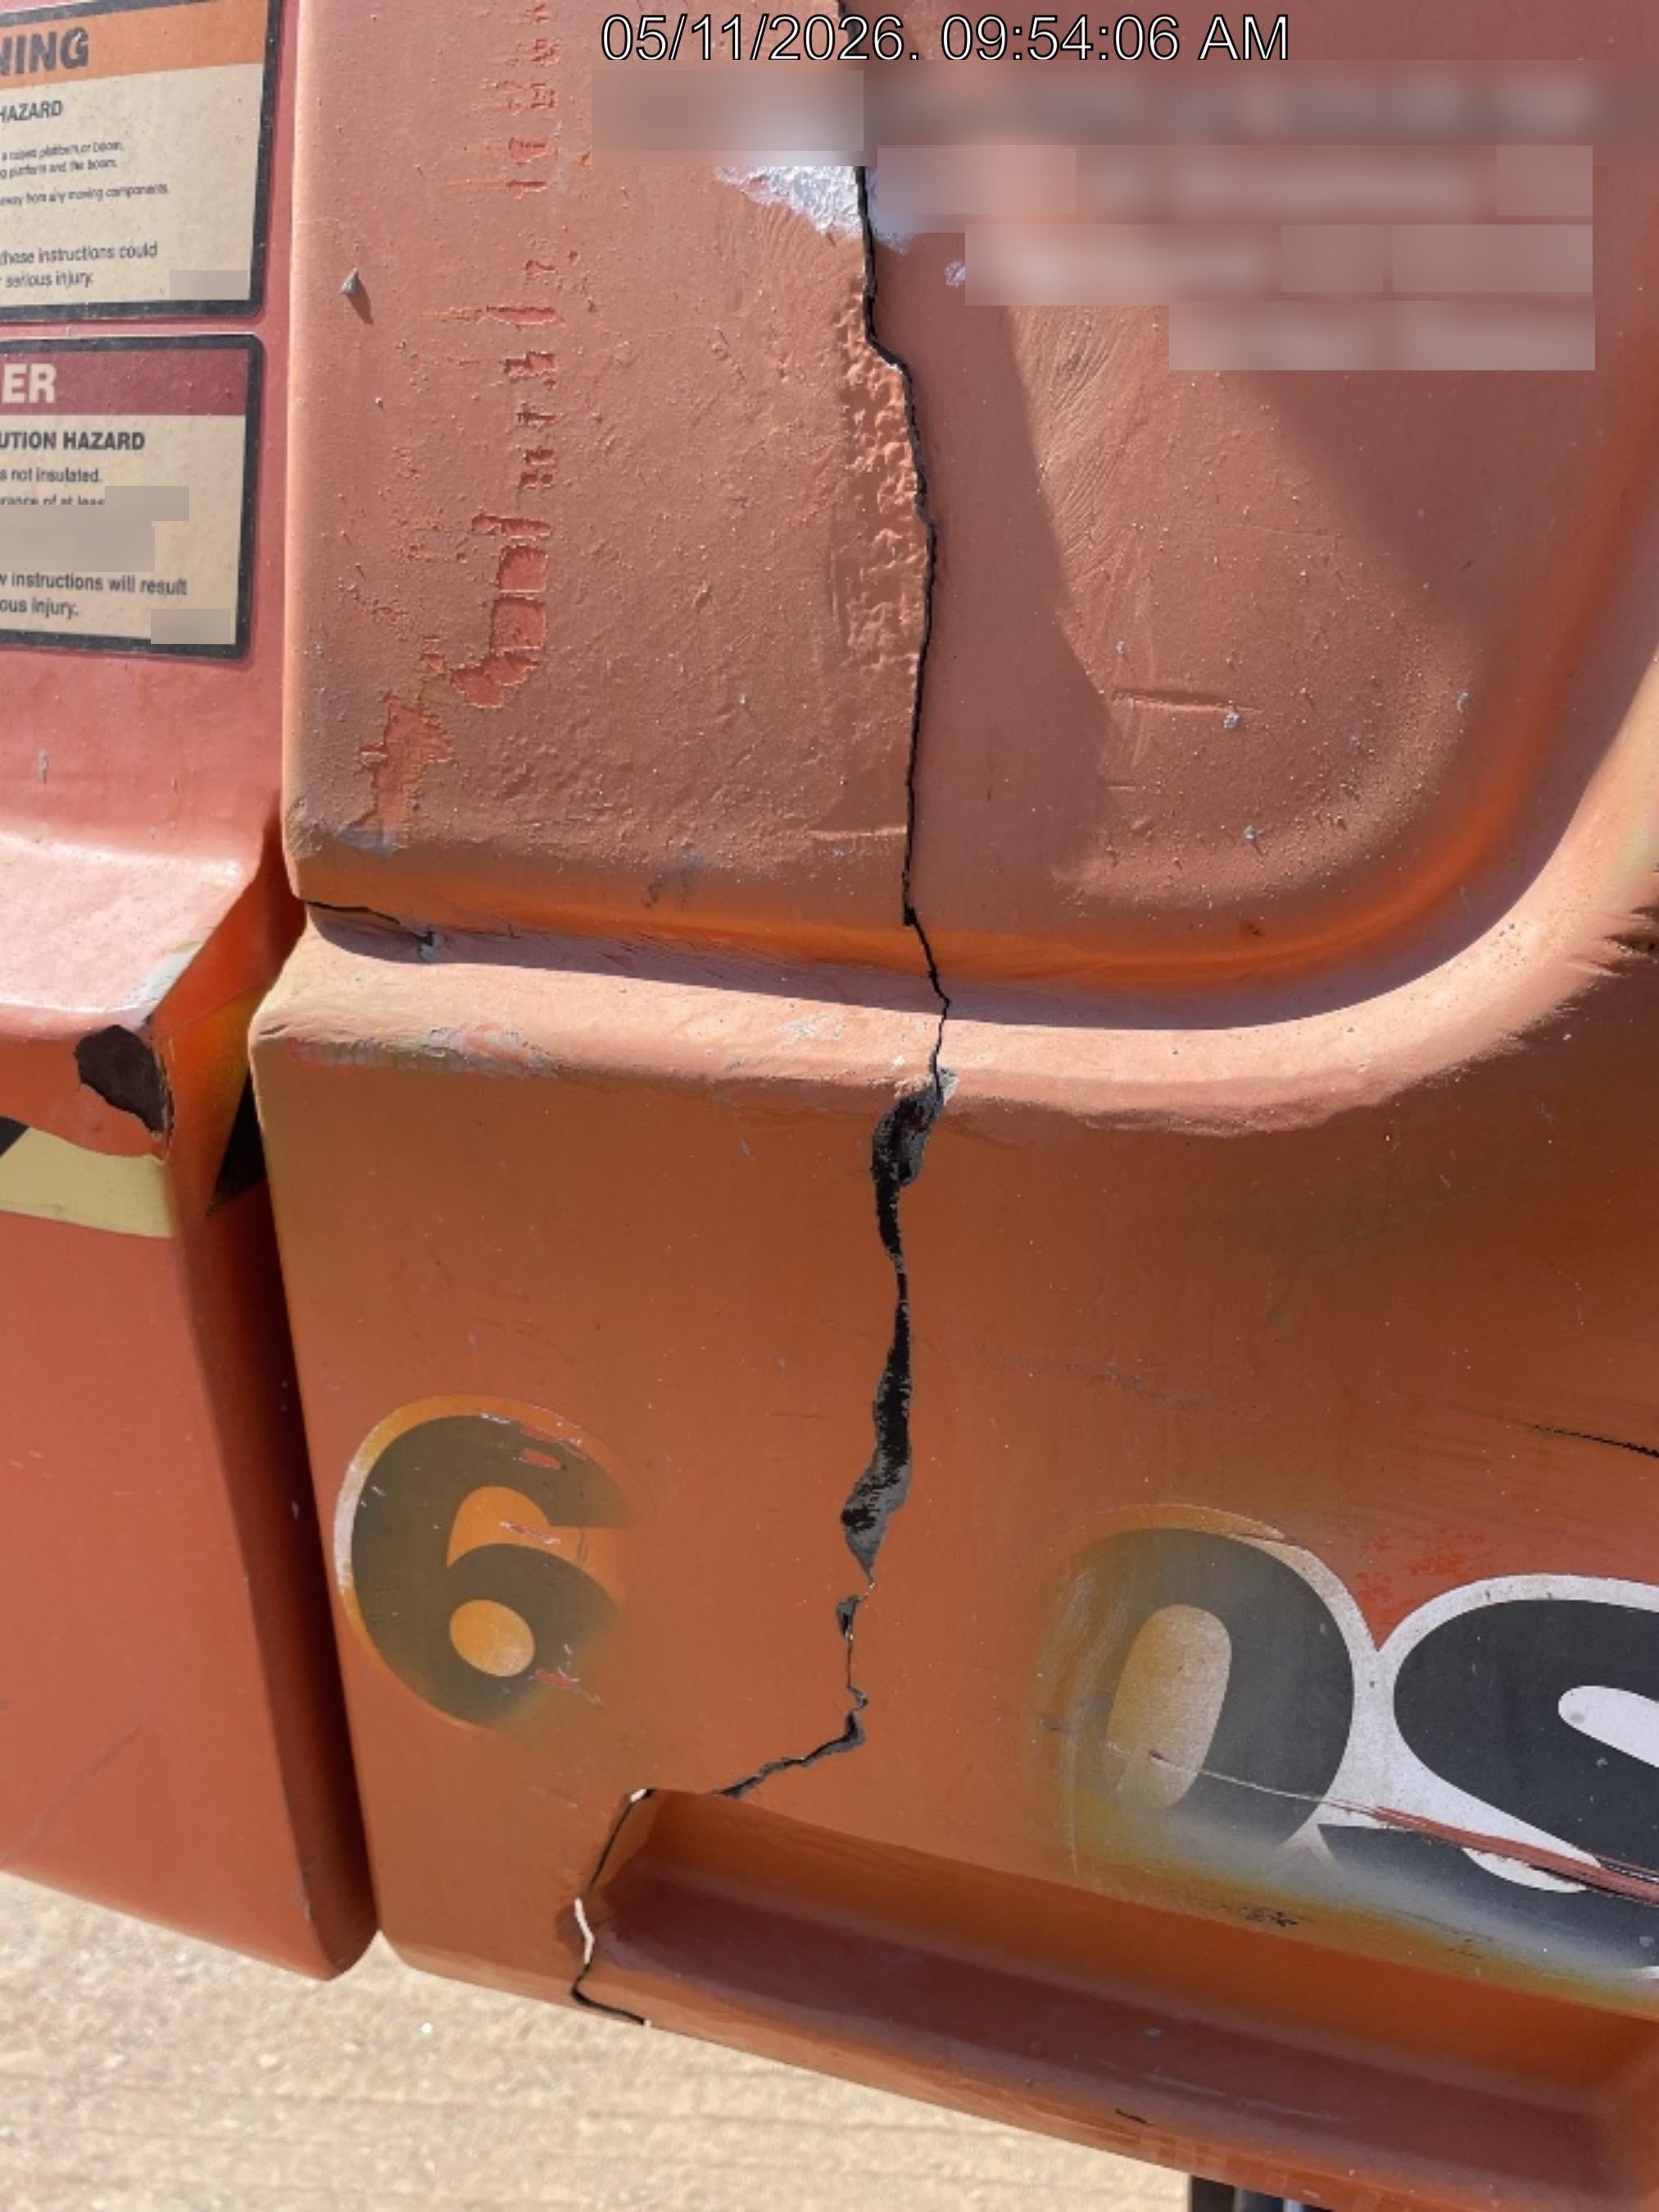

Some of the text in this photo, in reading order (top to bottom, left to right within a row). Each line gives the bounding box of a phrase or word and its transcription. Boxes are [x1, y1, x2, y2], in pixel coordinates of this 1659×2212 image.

[49, 161, 66, 173] and
[70, 159, 84, 171] the
[68, 186, 103, 202] moving
[39, 245, 116, 264] instructions
[119, 242, 158, 259] could
[7, 271, 52, 288] serious
[2, 361, 57, 405] ER
[63, 431, 146, 451] HAZARD
[11, 468, 32, 483] not
[36, 466, 103, 483] insulated.
[11, 571, 103, 591] instructions
[108, 574, 136, 593] will
[139, 577, 188, 596] result
